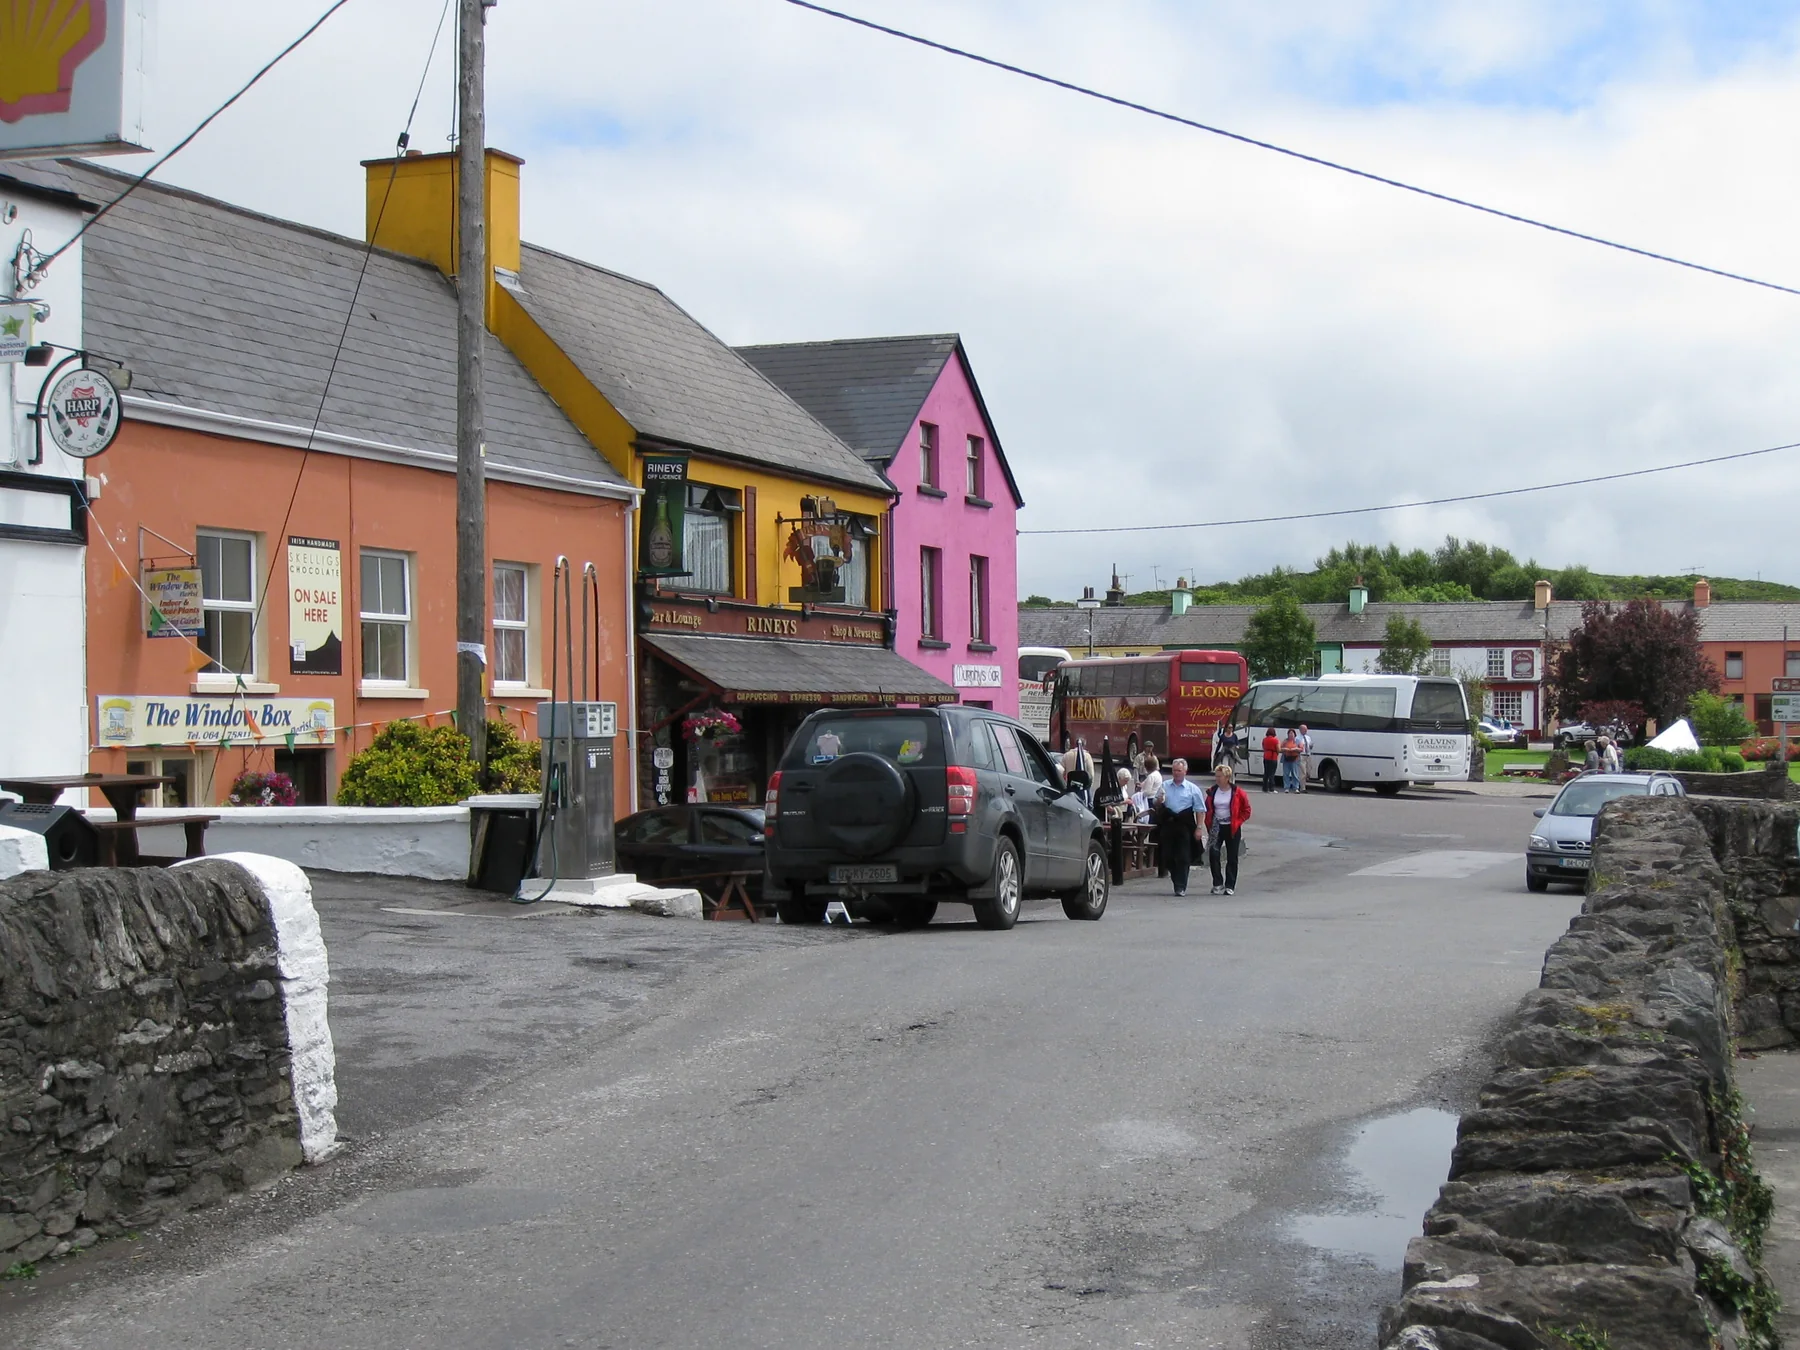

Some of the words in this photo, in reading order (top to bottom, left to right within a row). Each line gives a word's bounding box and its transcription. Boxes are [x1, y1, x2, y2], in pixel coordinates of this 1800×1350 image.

[0, 350, 25, 358] Lottery
[67, 399, 100, 413] HARP
[647, 463, 683, 474] RINEYS
[291, 537, 305, 545] IRISH
[306, 539, 336, 549] HANDMADE
[289, 551, 340, 567] SKELLIGS
[166, 573, 181, 582] The
[289, 565, 340, 577] CHOCOLATE
[149, 582, 181, 592] Window
[183, 582, 198, 590] Box
[294, 588, 311, 603] ON
[313, 589, 337, 605] SALE
[159, 600, 182, 608] Indoor
[304, 607, 328, 623] HERE
[666, 610, 672, 623] &
[672, 610, 702, 629] Lounge
[747, 616, 798, 634] RINEYS
[832, 624, 847, 639] Shop
[790, 693, 822, 702] ESPRESSO
[1180, 685, 1241, 698] LEONS
[145, 702, 179, 727] The
[184, 703, 257, 727] Window
[261, 704, 292, 727] Box
[1070, 697, 1107, 720] LEONS
[1188, 703, 1232, 723] Holidays
[187, 730, 201, 740] Tel.
[203, 731, 219, 740] 064
[732, 790, 748, 800] Coffee
